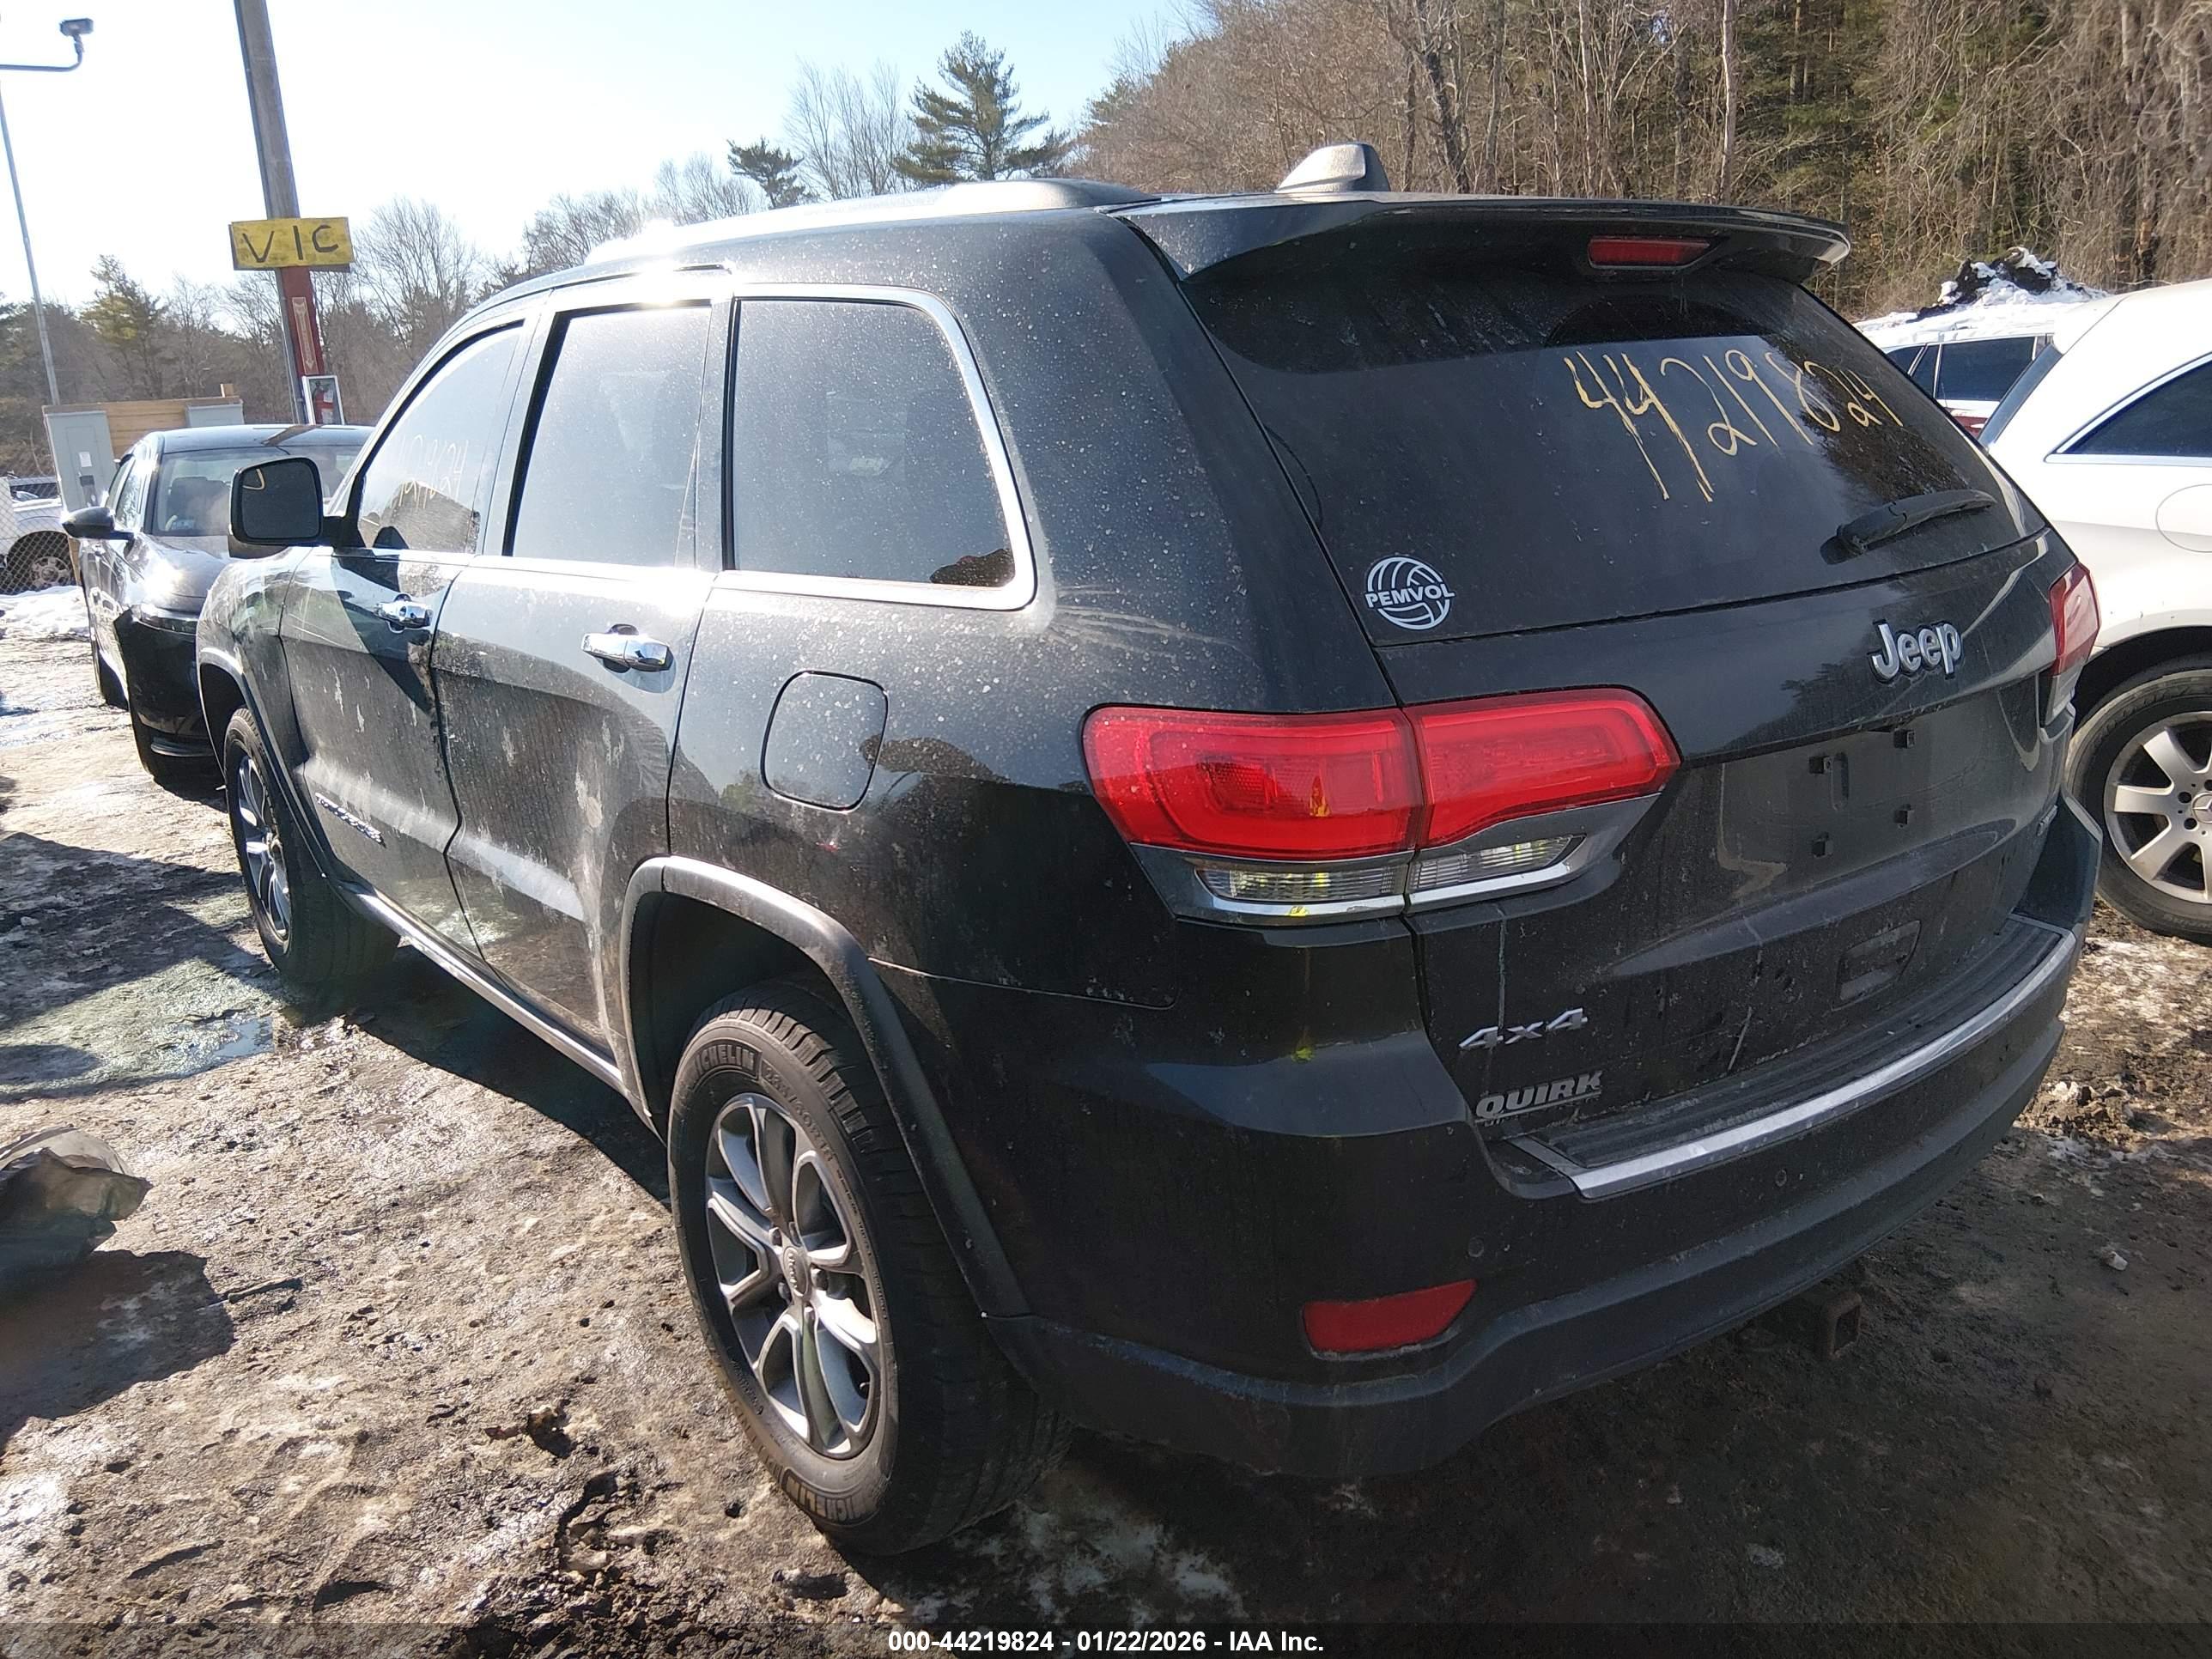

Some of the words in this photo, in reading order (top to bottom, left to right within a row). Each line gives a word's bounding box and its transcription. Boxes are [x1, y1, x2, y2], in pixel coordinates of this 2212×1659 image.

[1564, 349, 1904, 502] 44219824
[1365, 584, 1455, 608] PEMVOL
[1870, 622, 1962, 678] Jeep
[1475, 1072, 1602, 1119] QUIRK
